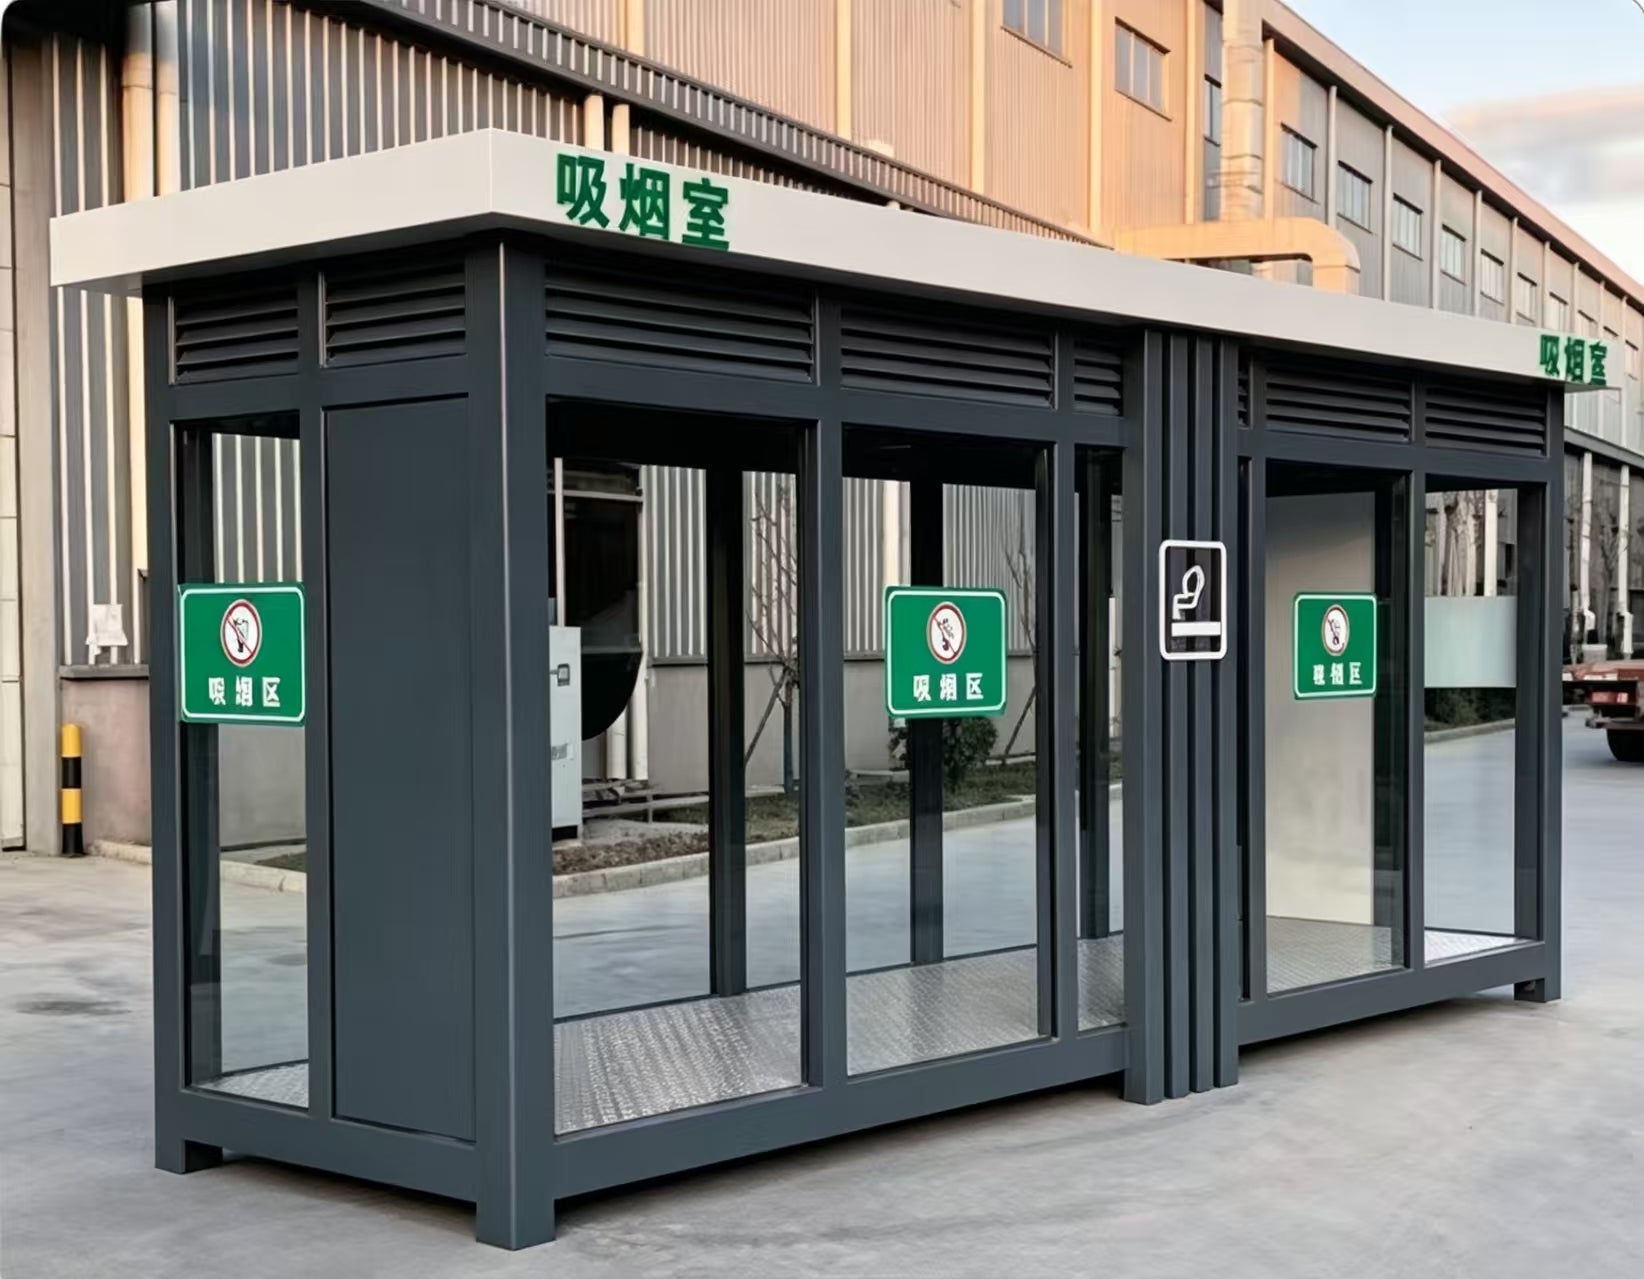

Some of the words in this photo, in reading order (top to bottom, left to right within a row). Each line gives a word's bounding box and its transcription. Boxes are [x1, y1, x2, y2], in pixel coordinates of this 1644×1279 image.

[556, 153, 730, 251] 吸烟室
[1540, 334, 1608, 387] 吸烟室
